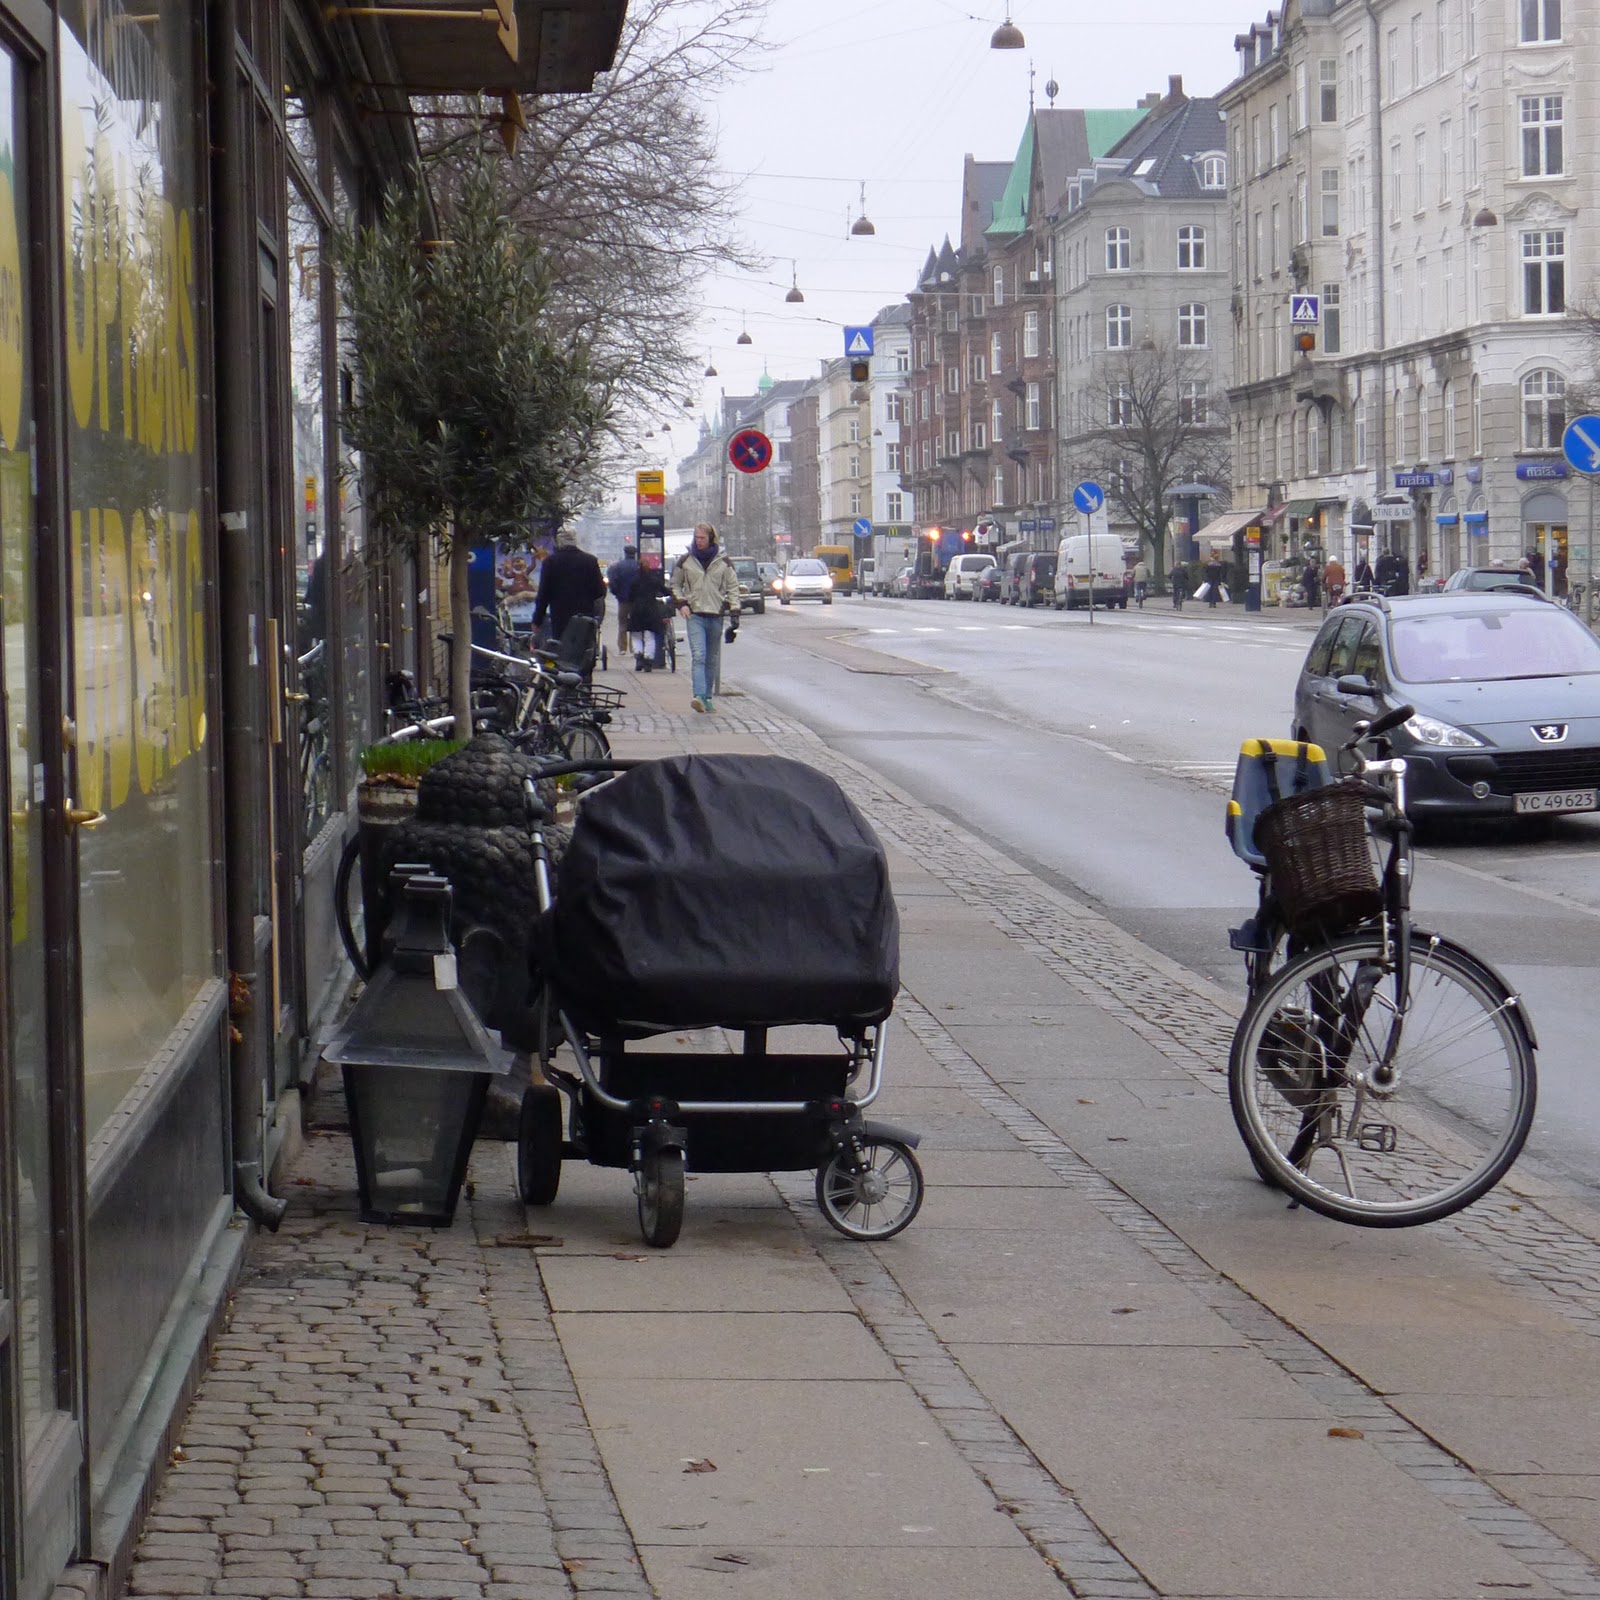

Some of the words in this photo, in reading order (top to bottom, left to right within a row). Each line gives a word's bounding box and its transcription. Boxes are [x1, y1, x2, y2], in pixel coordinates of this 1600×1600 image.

[1526, 466, 1556, 477] matas
[1400, 474, 1431, 486] matas
[1373, 507, 1393, 517] STINE
[1519, 796, 1541, 810] YC
